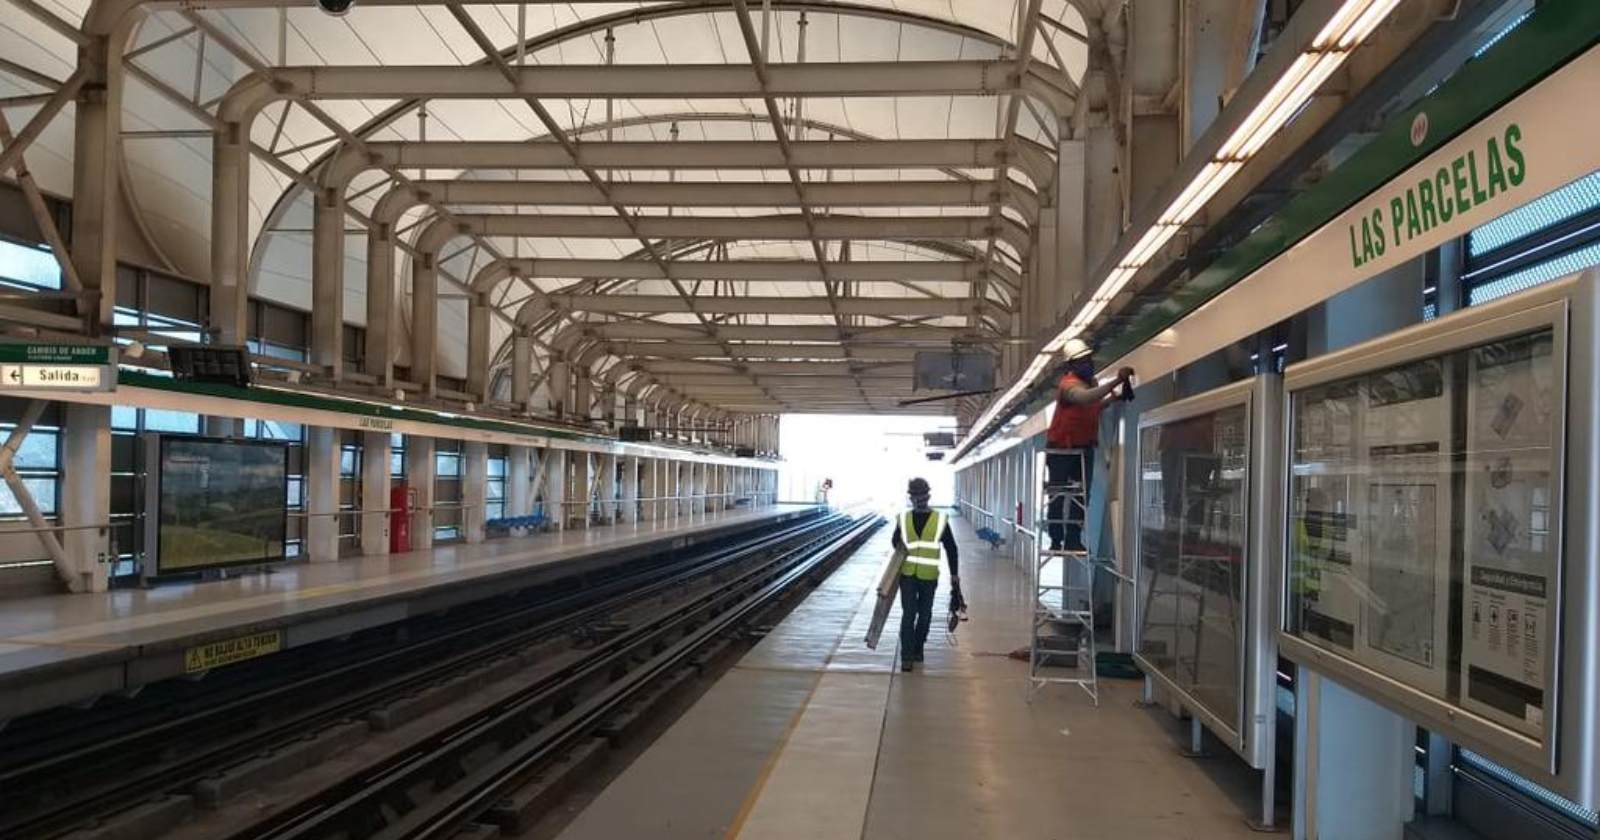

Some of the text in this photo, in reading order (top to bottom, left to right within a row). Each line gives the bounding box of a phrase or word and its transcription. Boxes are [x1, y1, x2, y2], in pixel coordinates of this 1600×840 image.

[1350, 123, 1526, 268] LAS PARCELAS
[40, 369, 79, 381] Salida
